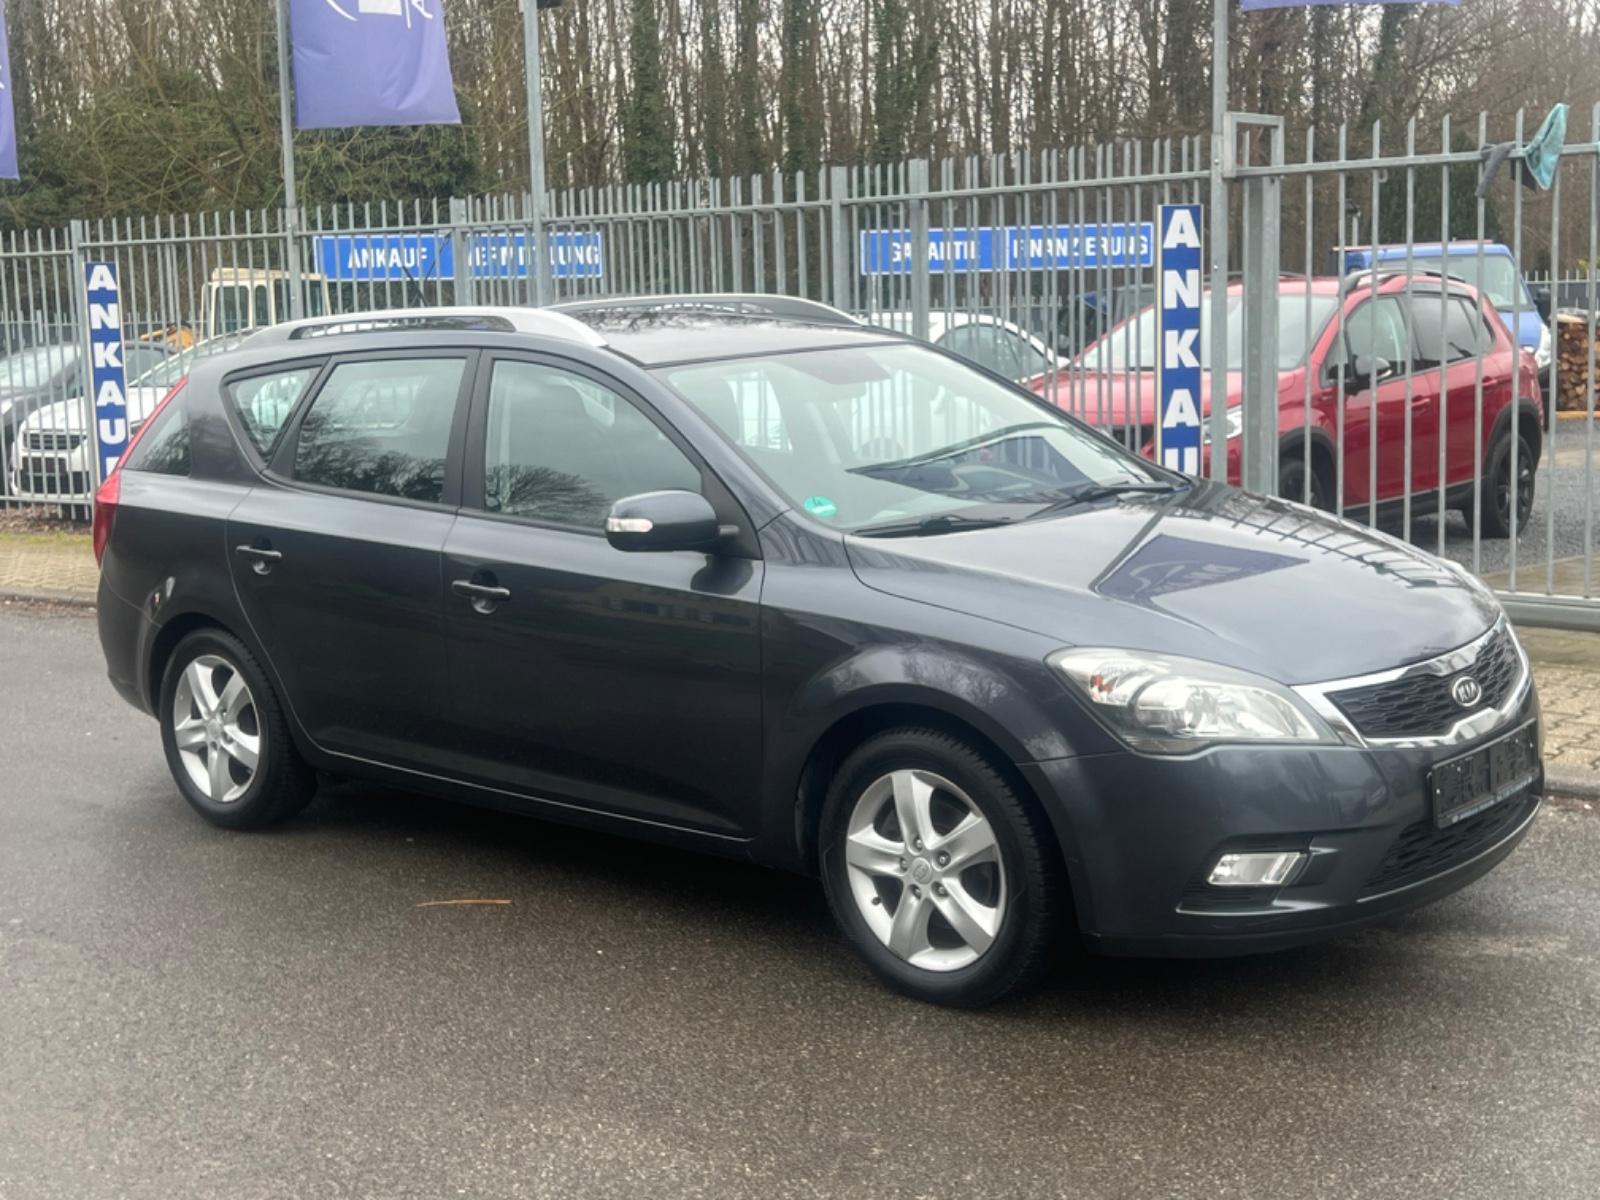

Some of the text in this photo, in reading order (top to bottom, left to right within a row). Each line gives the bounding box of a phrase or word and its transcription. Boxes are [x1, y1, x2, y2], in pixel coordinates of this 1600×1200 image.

[347, 246, 428, 269] ANKAUF
[890, 240, 977, 262] GAANTI
[1012, 234, 1149, 259] FNANZERUNG
